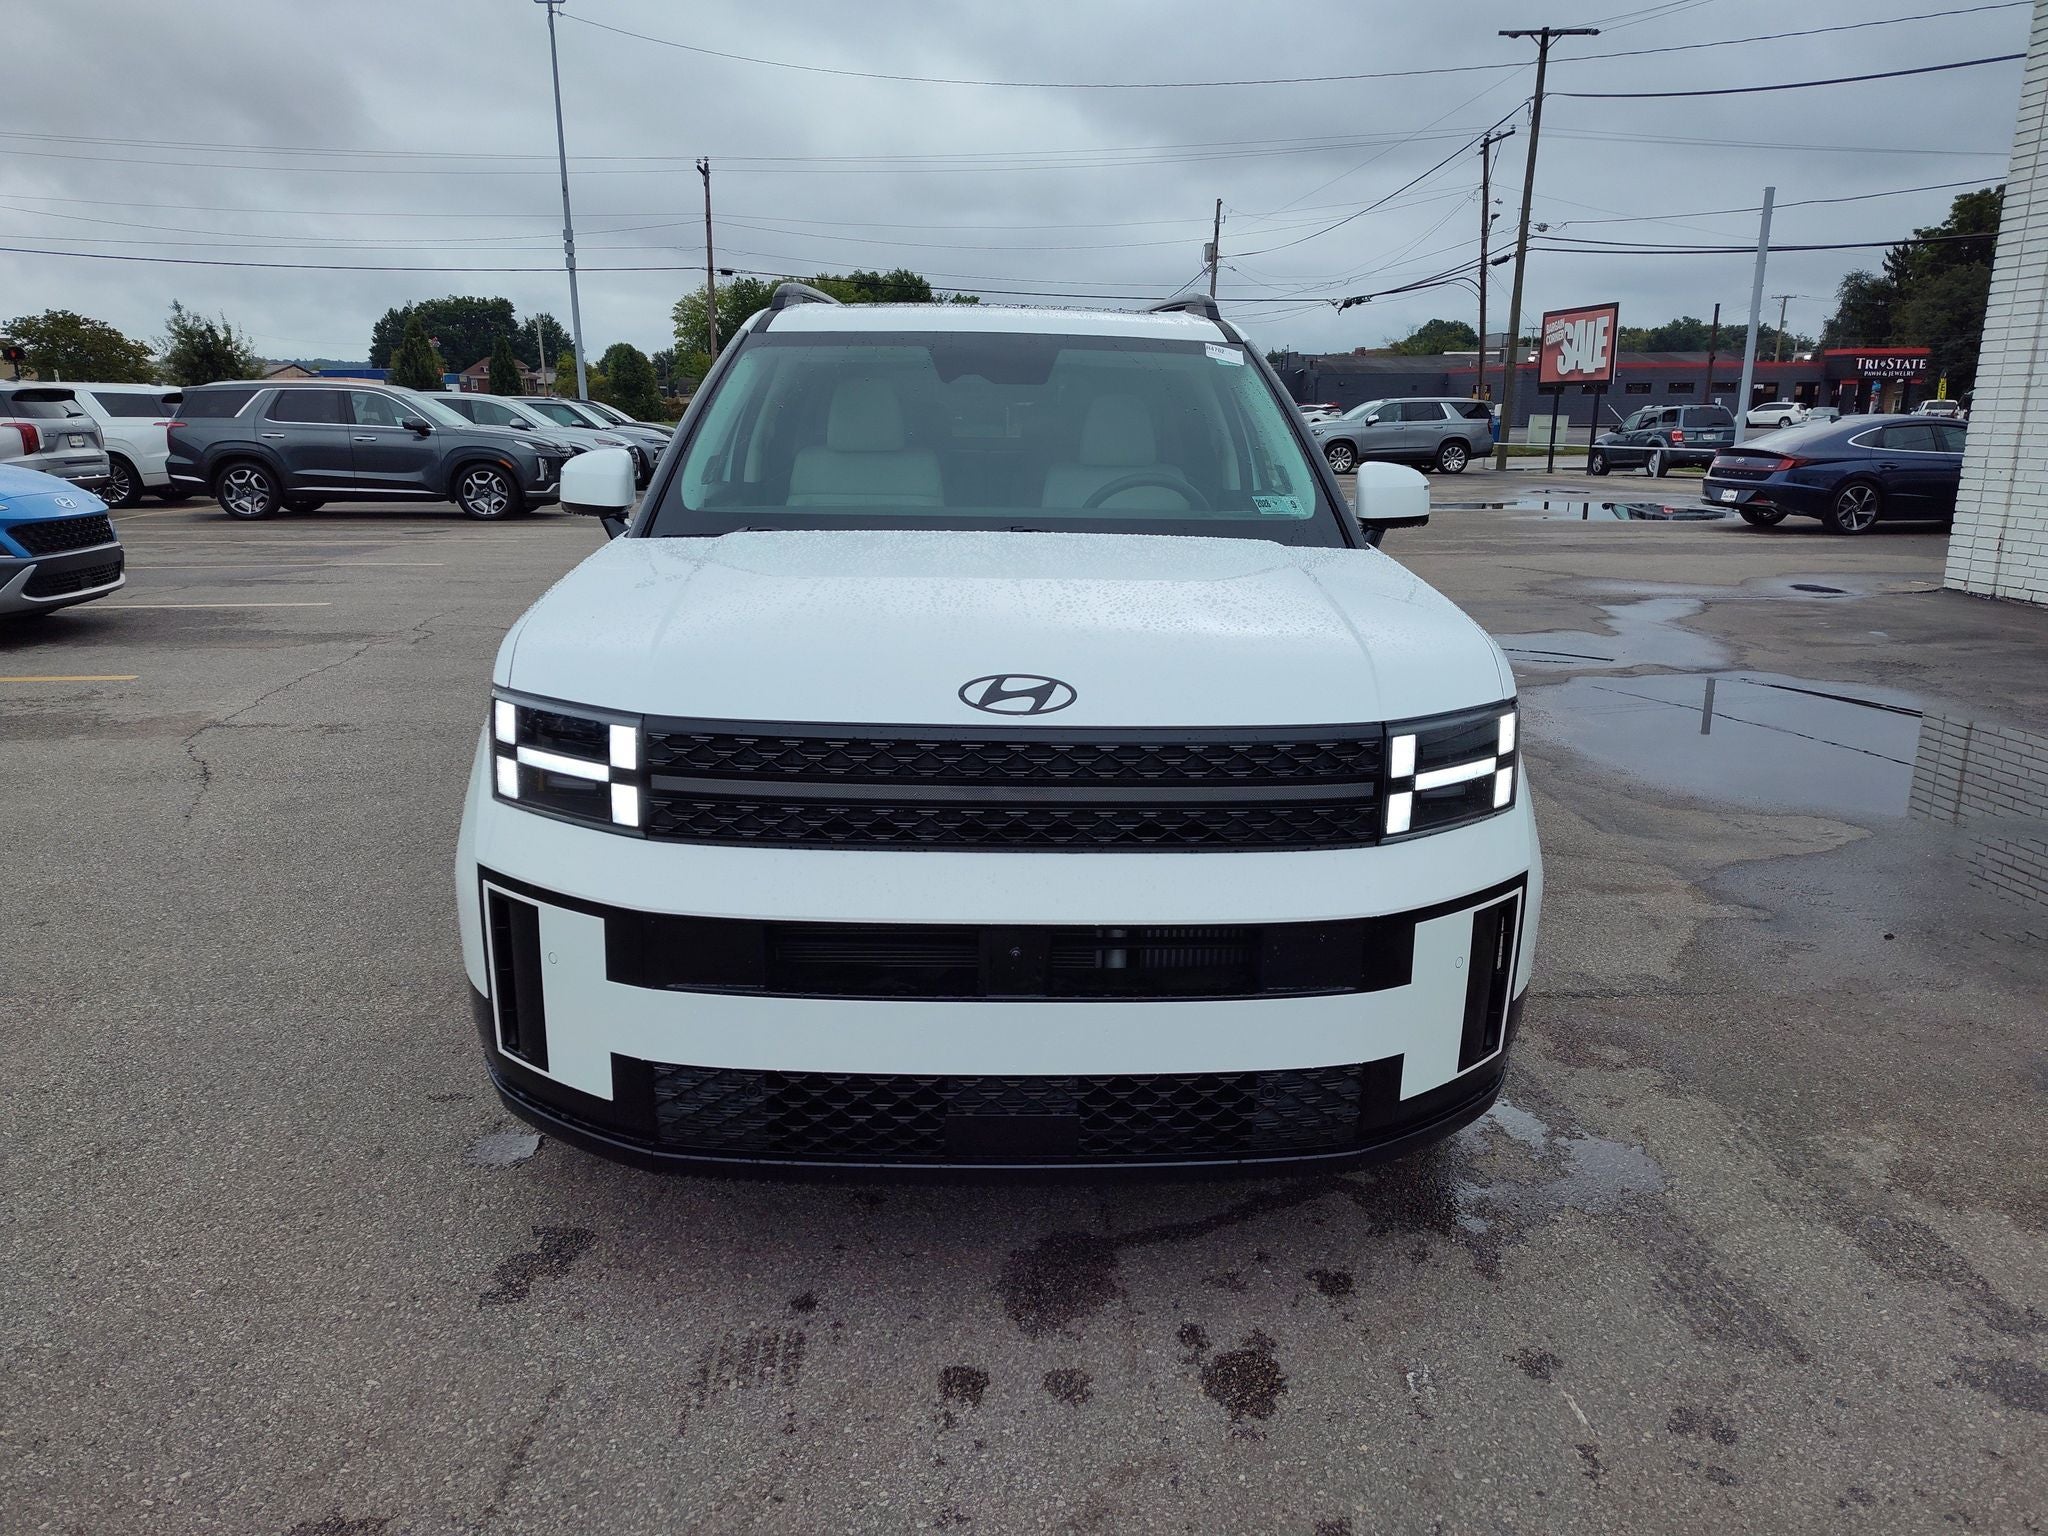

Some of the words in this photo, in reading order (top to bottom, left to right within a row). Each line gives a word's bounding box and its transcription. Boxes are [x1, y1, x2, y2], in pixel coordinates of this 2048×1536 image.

[1546, 330, 1564, 345] CORNER
[1557, 316, 1609, 375] SALE
[1290, 500, 1297, 508] 9
